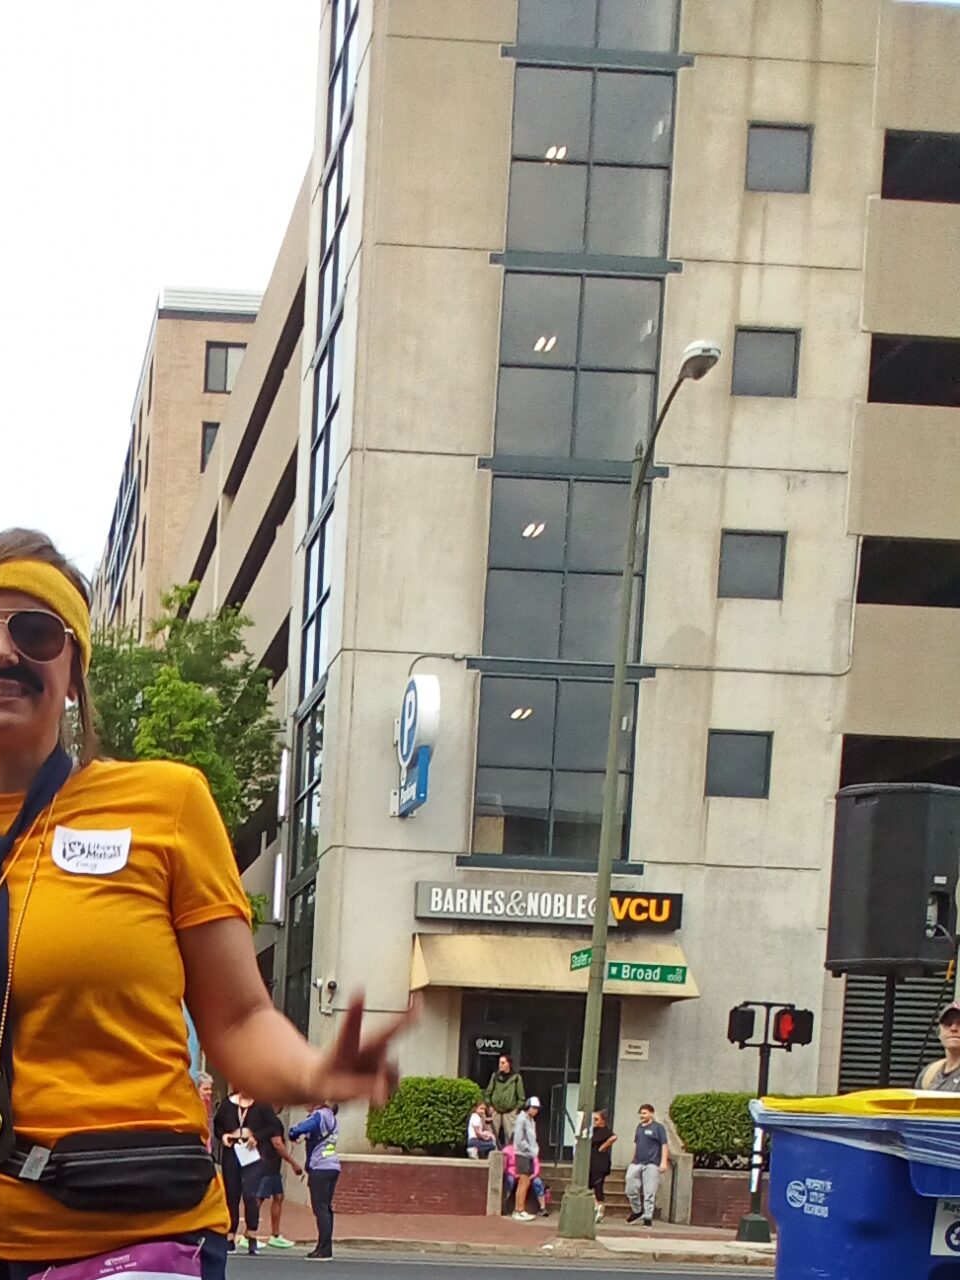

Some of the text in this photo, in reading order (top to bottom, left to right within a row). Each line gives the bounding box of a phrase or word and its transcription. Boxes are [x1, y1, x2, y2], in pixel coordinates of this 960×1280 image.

[402, 689, 416, 756] P
[610, 897, 671, 923] VCU
[621, 964, 661, 981] Broad
[484, 1039, 504, 1049] VCU
